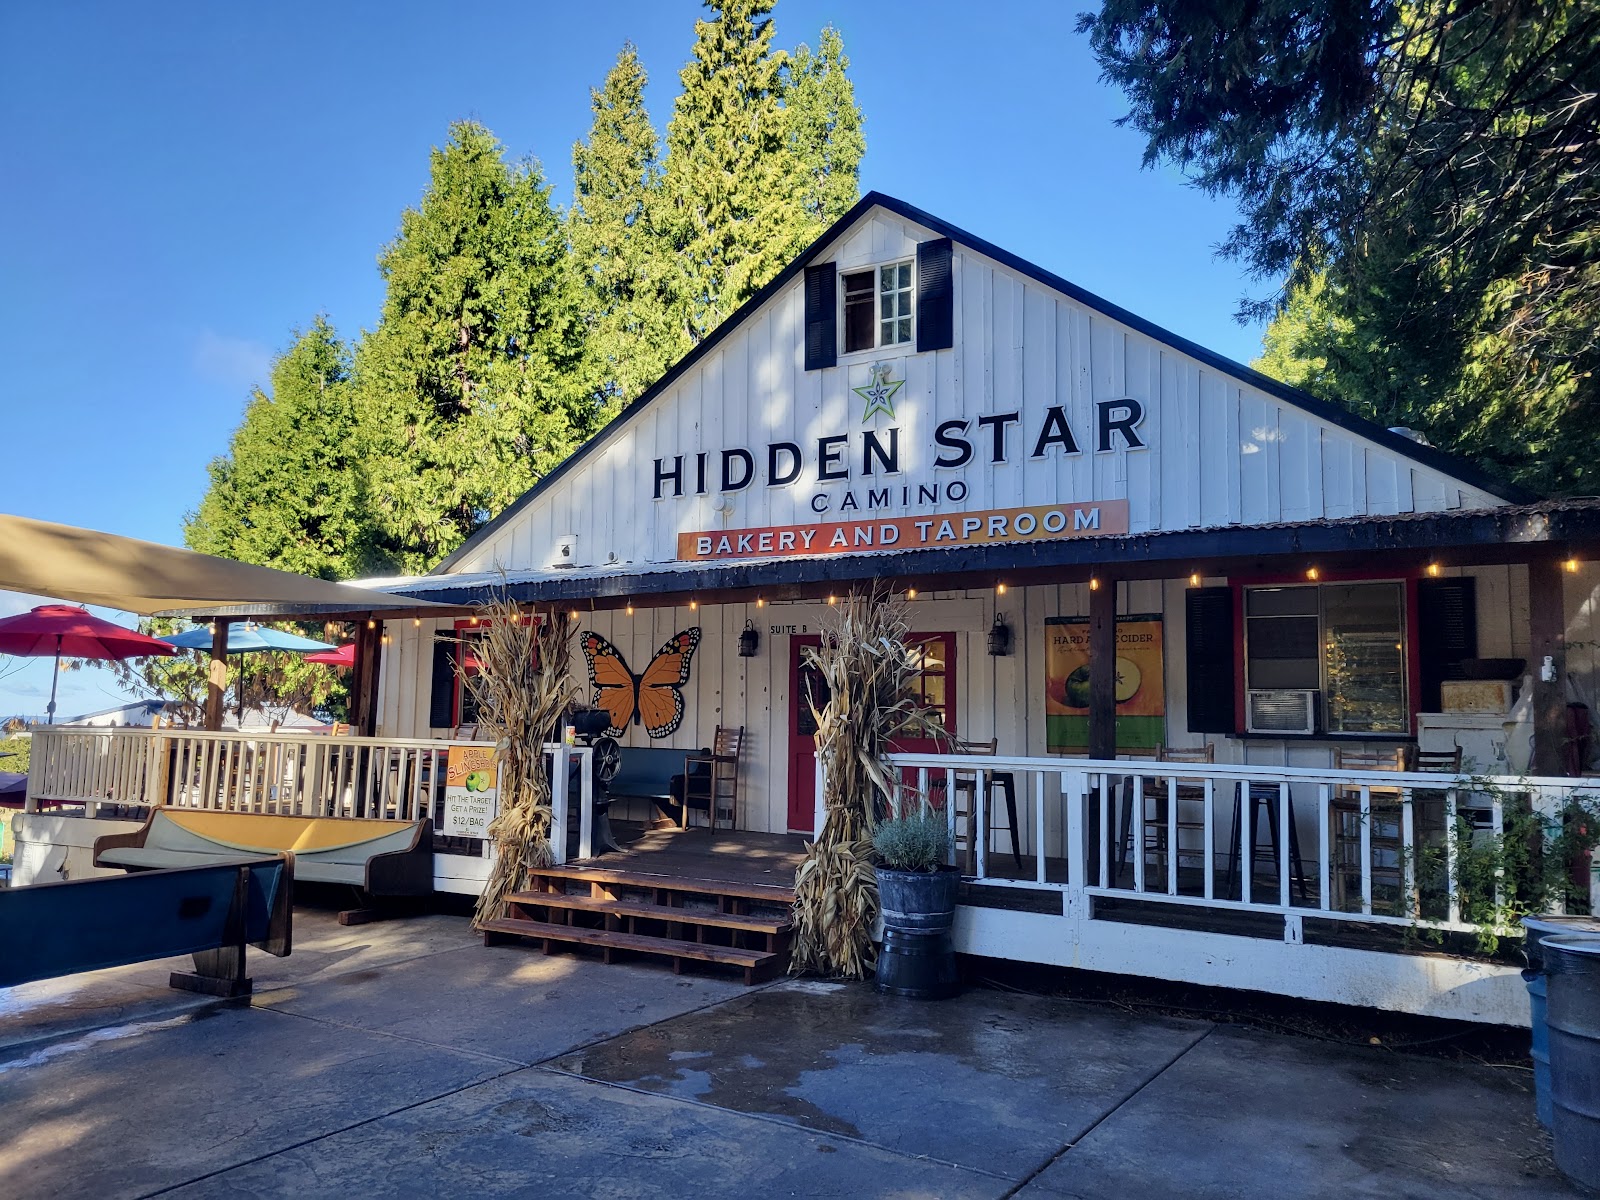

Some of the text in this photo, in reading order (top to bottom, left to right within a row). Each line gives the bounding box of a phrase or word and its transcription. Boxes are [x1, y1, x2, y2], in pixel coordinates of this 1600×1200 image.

[652, 398, 1145, 499] HIDDEN STAR
[811, 481, 967, 513] CAMINO
[696, 507, 1100, 555] BAKERY AND TAPROOM
[770, 624, 807, 634] SUITE B
[1053, 636, 1084, 645] HARD
[1120, 633, 1153, 643] CIDER
[464, 750, 486, 759] APPLE
[448, 759, 496, 778] SLINGSHOTS
[451, 804, 463, 812] GET
[468, 806, 488, 814] PRIZE!
[452, 815, 484, 827] $12/BAG
